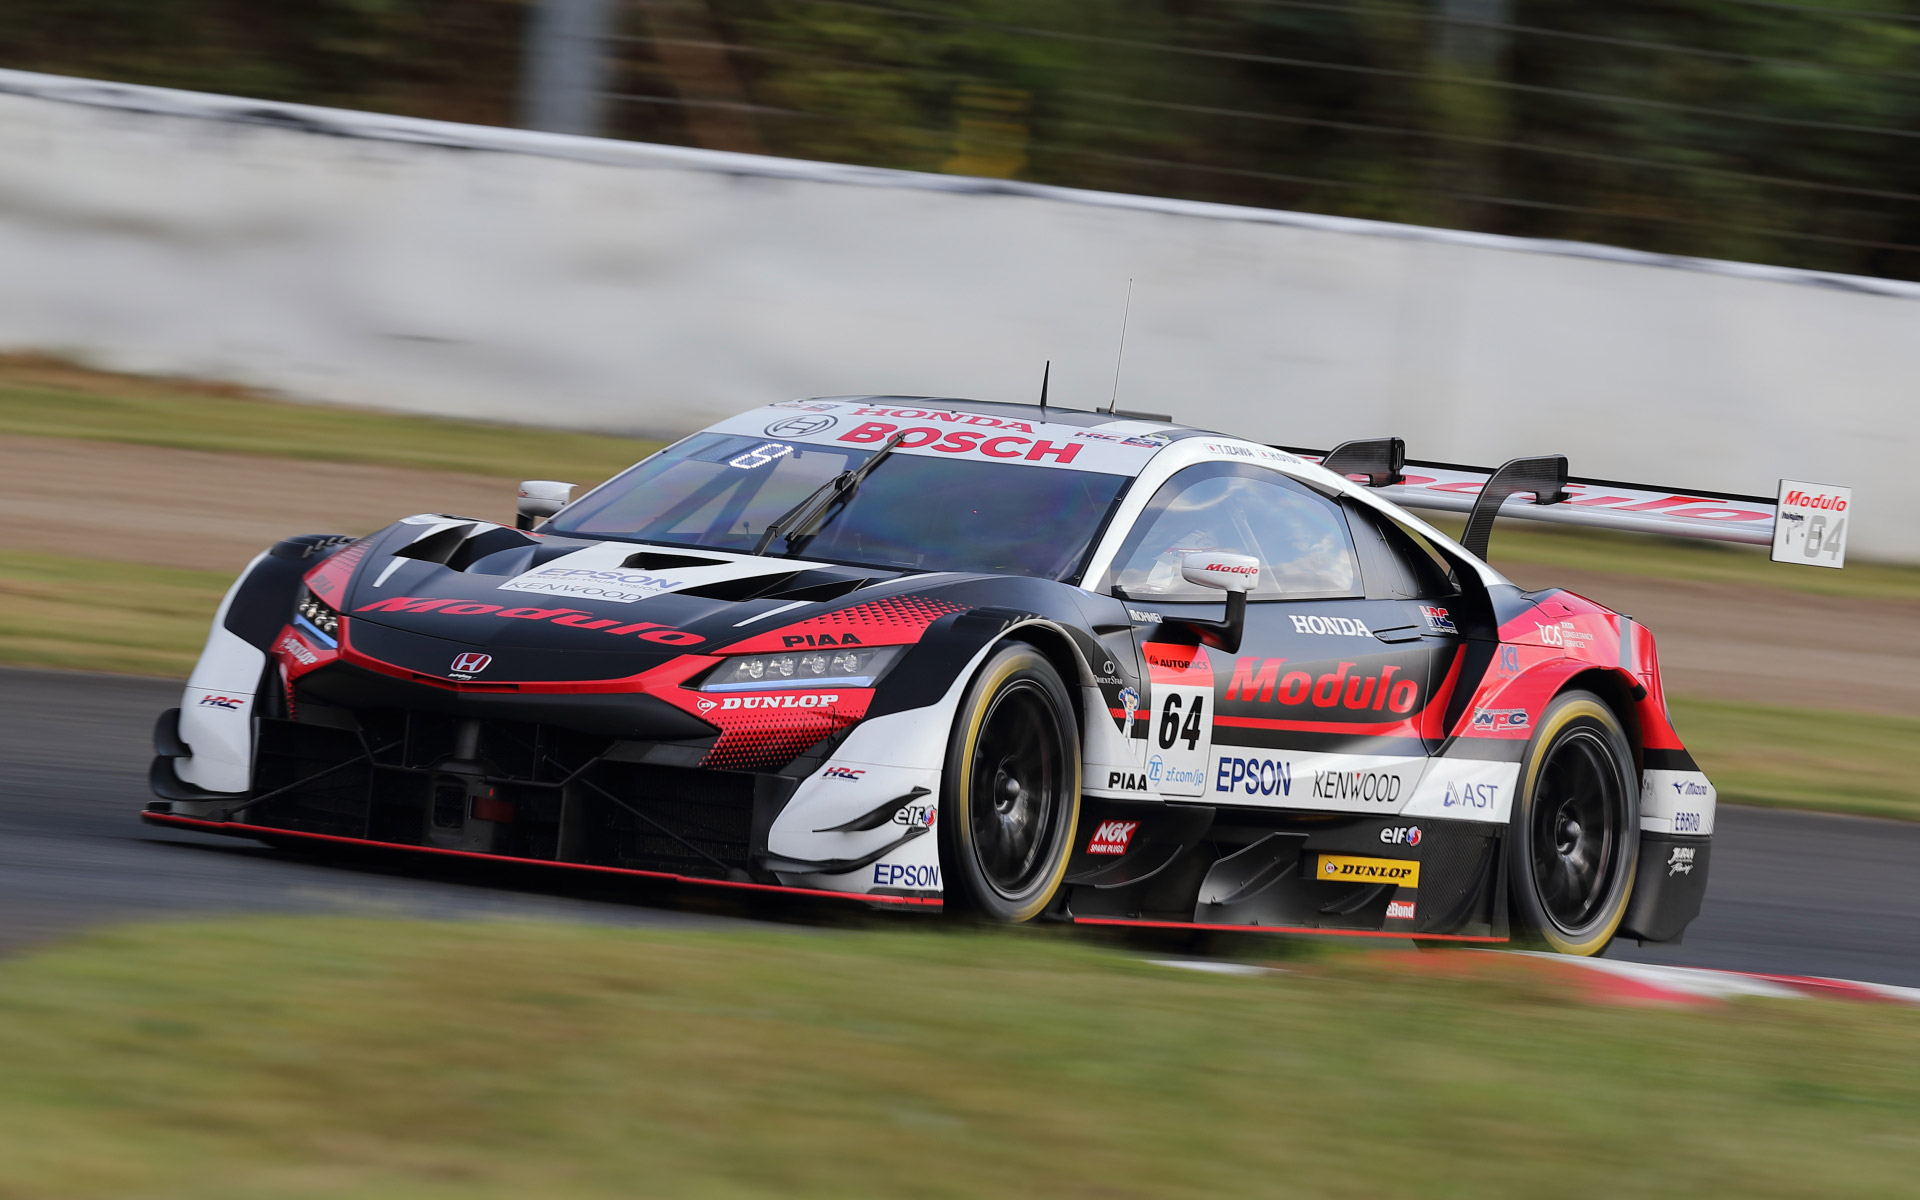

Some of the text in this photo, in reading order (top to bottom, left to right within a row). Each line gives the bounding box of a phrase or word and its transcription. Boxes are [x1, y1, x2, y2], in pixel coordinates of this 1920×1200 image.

[848, 407, 1035, 434] HONDA
[837, 421, 1084, 463] BOSCH
[1783, 490, 1847, 511] Modulo
[1803, 515, 1845, 560] 64
[537, 568, 684, 588] EPSON
[1205, 563, 1259, 574] Modulo
[506, 582, 642, 601] KENWOOD
[352, 596, 706, 646] Modulo
[1288, 615, 1375, 638] HONDA
[1419, 605, 1456, 630] HRC
[781, 633, 862, 648] PIAA
[1160, 659, 1208, 670] AUTOBACS
[1224, 656, 1418, 714] Modulo
[199, 695, 245, 710] HRC
[720, 694, 838, 710] DUNLOP
[1159, 693, 1203, 750] 64
[822, 767, 866, 780] HRC
[1108, 772, 1147, 791] PIAA
[1166, 767, 1204, 786] zf.com/jp
[1216, 757, 1291, 796] EPSON
[1312, 770, 1401, 802] KENWOOD
[1462, 782, 1498, 809] AST
[893, 806, 925, 827] elf
[1094, 822, 1136, 844] NGK
[1380, 826, 1407, 844] elf
[873, 863, 939, 886] EPSON
[1340, 864, 1412, 878] DUNLOP
